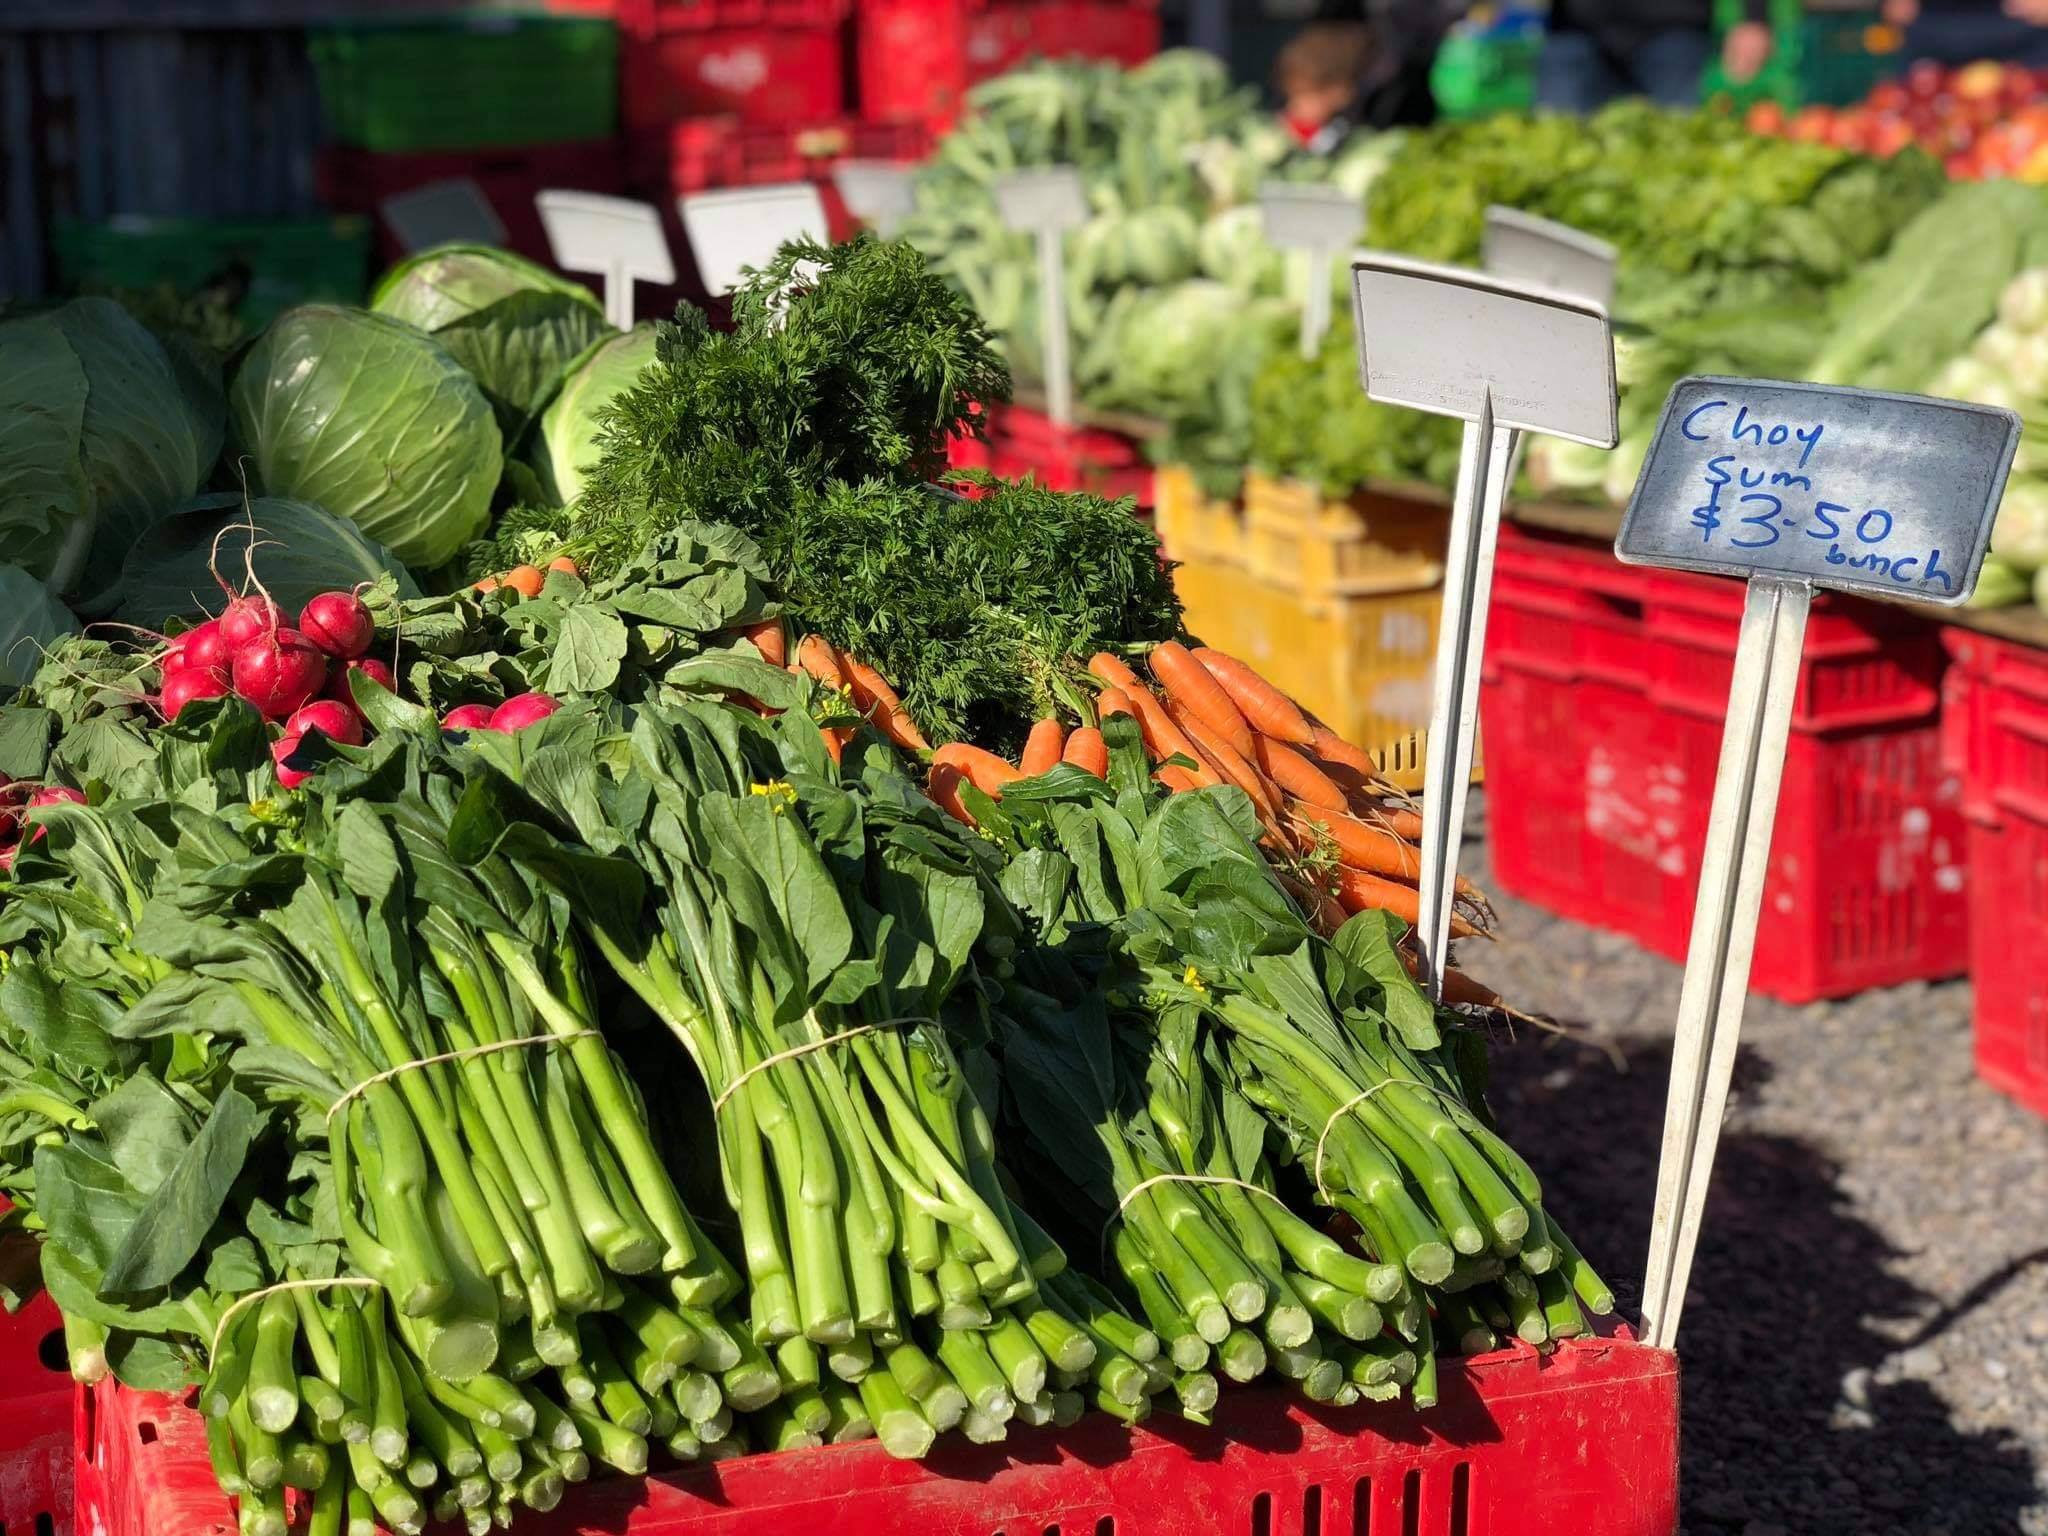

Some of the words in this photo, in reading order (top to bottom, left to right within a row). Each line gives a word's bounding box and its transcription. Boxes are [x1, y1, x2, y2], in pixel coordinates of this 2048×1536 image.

[1681, 401, 1824, 470] Choy
[1690, 483, 1893, 548] $3.50
[1825, 545, 1952, 590] bunch
